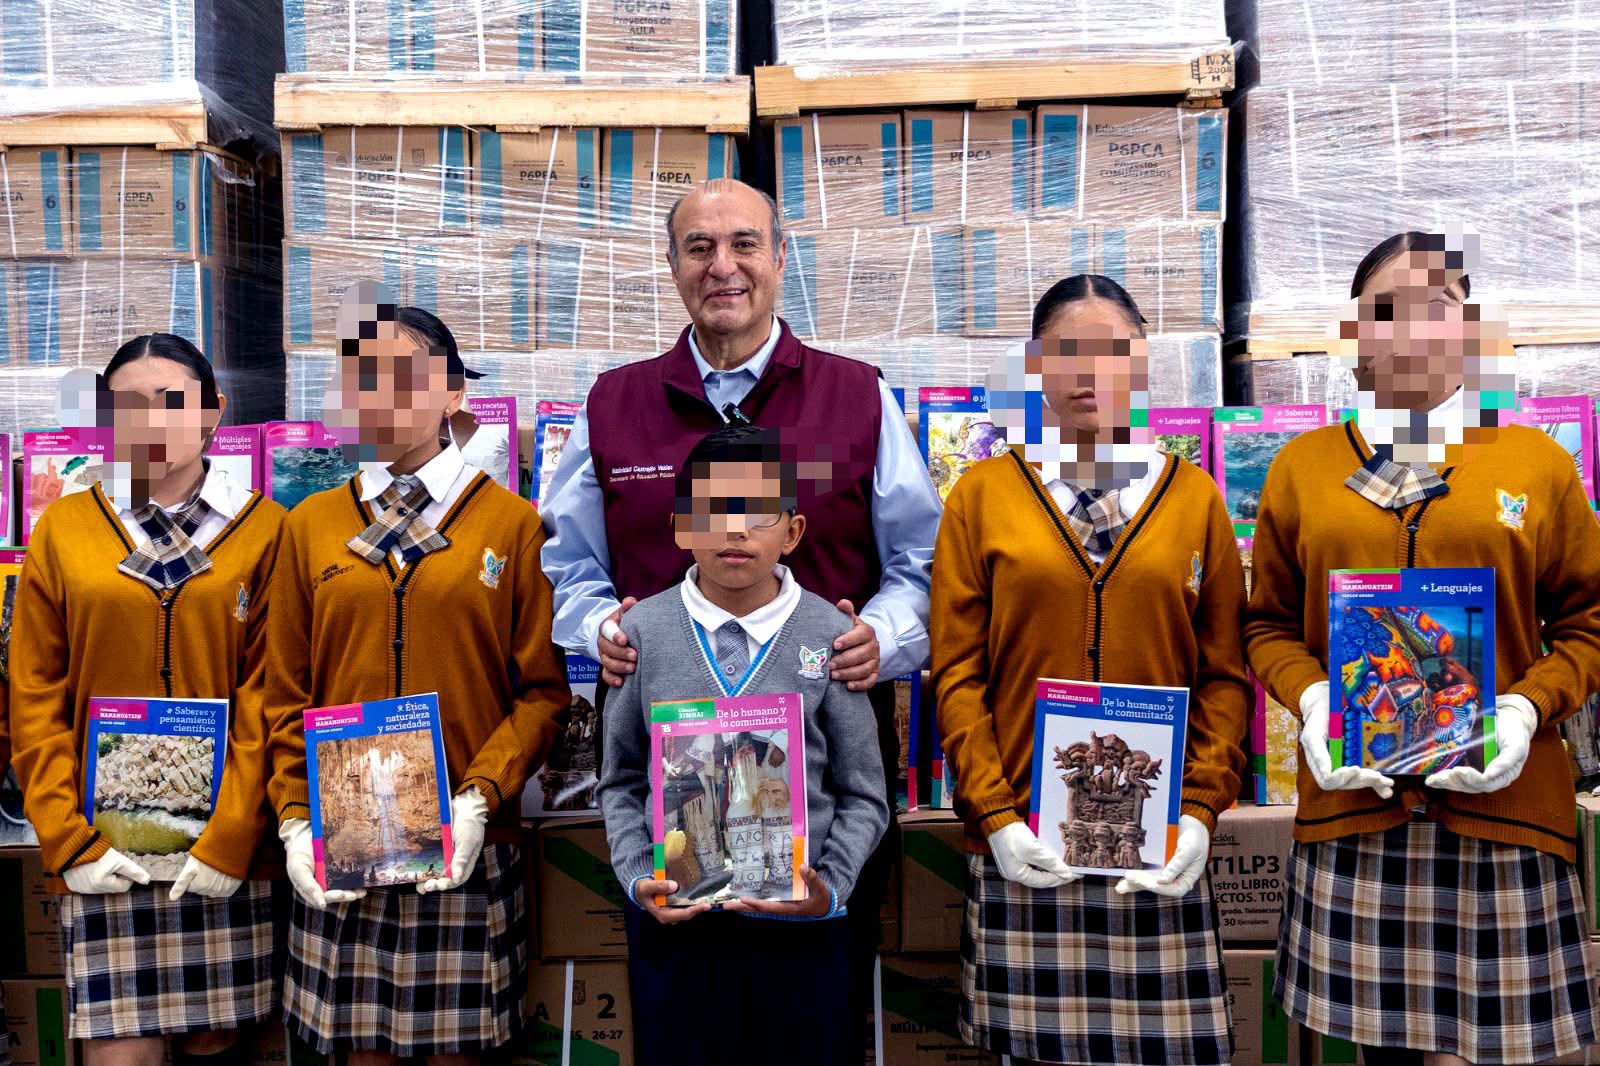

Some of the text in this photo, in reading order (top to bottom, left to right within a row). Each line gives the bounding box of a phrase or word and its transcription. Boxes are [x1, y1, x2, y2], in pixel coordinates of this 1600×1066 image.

[1108, 143, 1164, 157] P6PCA
[46, 195, 56, 209] 6
[175, 198, 186, 212] 6
[1284, 409, 1312, 417] Saberes
[1164, 415, 1201, 427] Lenguajes
[219, 434, 252, 444] Múltiples
[1430, 583, 1483, 595] Lenguajes
[567, 663, 600, 672] De lo hu
[405, 700, 430, 712] Ética,
[1102, 697, 1175, 713] De lo humano y
[174, 706, 216, 718] Saberes y
[385, 711, 431, 723] naturaleza
[716, 706, 787, 719] De lo humano y
[1104, 706, 1174, 720] lo comunitario
[159, 715, 216, 725] pensamiento
[719, 716, 788, 728] lo comunitario
[172, 724, 216, 733] científico
[377, 719, 431, 735] y sociedades
[1212, 833, 1235, 842] ción
[1212, 855, 1280, 875] T1LP3
[1241, 878, 1280, 890] LIBRO
[1216, 891, 1283, 904] ECTOS. TOM
[1224, 918, 1236, 926] 30
[597, 992, 617, 1019] 2
[592, 1030, 624, 1040] 26-27
